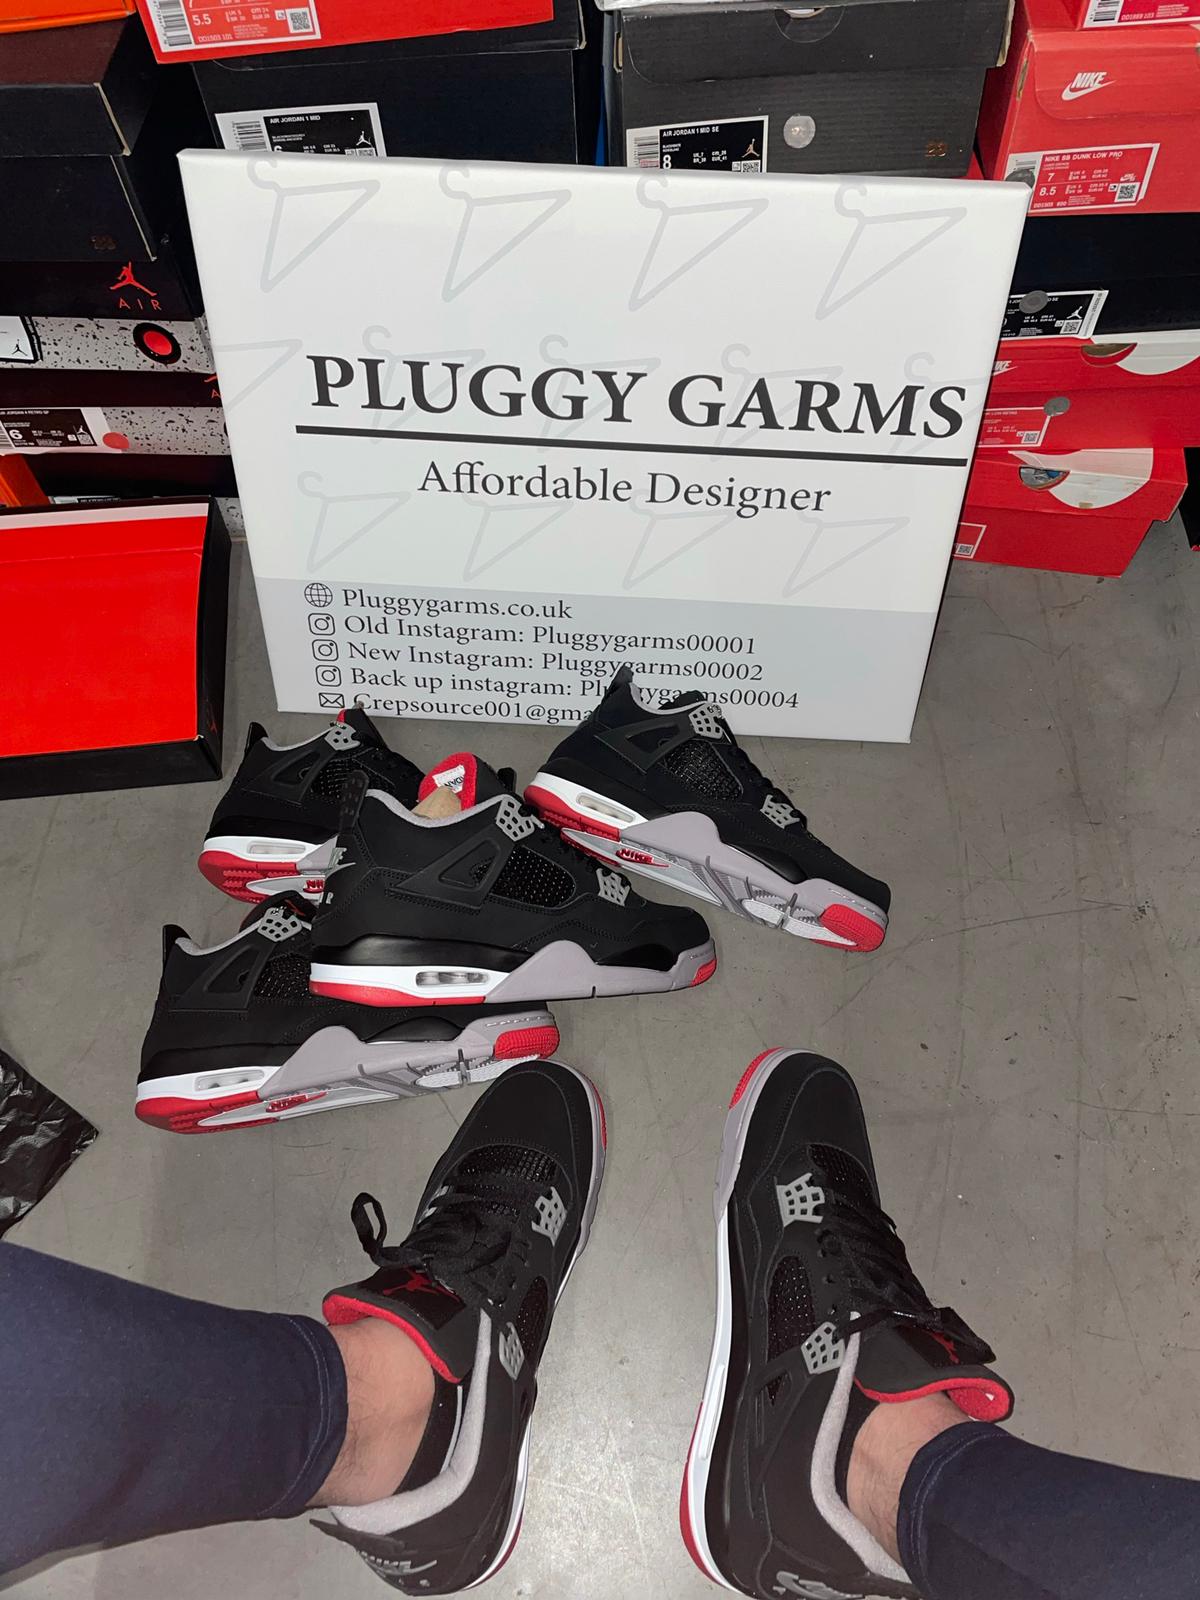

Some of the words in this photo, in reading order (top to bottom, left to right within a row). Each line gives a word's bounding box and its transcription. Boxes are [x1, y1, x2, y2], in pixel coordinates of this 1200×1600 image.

[192, 13, 212, 26] 5.5
[1071, 71, 1107, 89] NIKE
[281, 115, 304, 124] JORDAN
[673, 128, 696, 136] JORDAN
[662, 154, 672, 169] 8
[1047, 173, 1055, 182] 7
[1039, 186, 1057, 196] 8.5
[119, 298, 162, 311] AIR
[993, 360, 1012, 371] IKE
[306, 355, 648, 423] PLUGGY
[668, 374, 966, 439] GARMS
[9, 429, 23, 440] 6
[417, 460, 633, 502] Affordable
[645, 472, 831, 519] Designer
[342, 588, 573, 618] Pluggygarms.co.uk
[344, 615, 389, 635] Old
[397, 619, 524, 645] Instagram:
[532, 626, 755, 655] Pluggygarms00001
[347, 641, 401, 662] New
[408, 646, 533, 671] Instagram:
[351, 668, 407, 687] Back
[414, 676, 443, 694] up
[450, 674, 572, 699] instagram:
[353, 692, 594, 724] Crepsource001@gma
